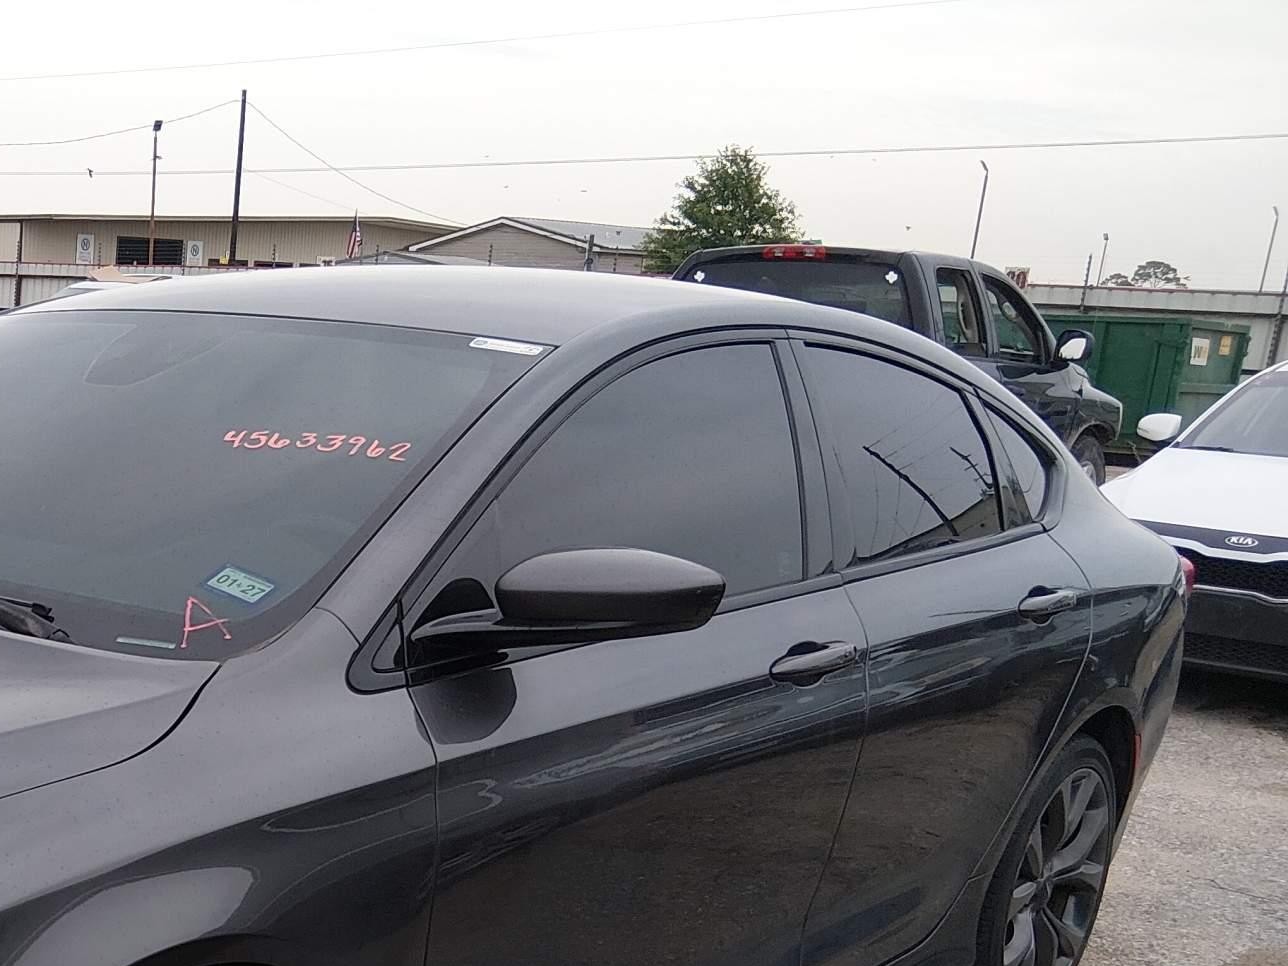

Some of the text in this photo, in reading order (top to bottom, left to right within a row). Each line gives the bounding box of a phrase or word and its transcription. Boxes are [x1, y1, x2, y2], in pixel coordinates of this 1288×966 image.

[223, 430, 411, 462] 45633962
[1230, 536, 1253, 545] KIA
[180, 596, 232, 648] A
